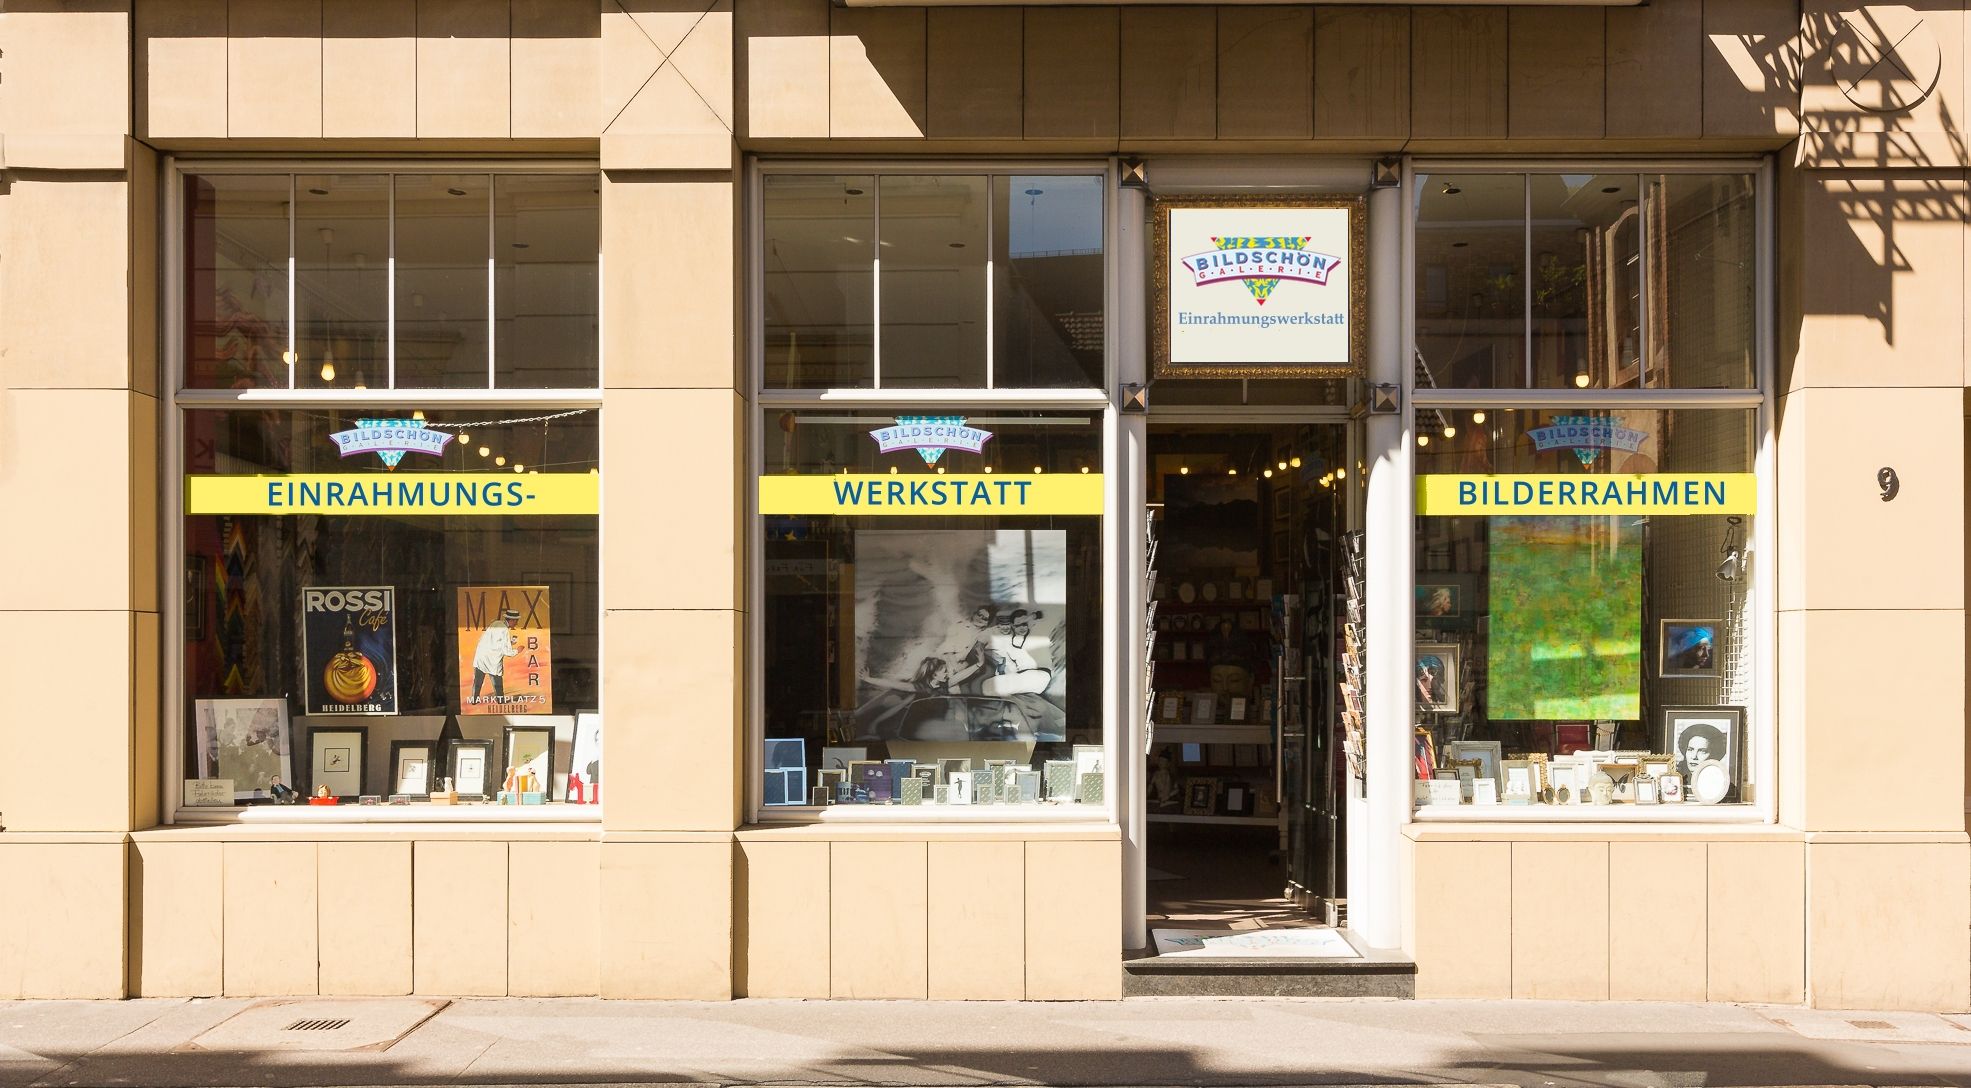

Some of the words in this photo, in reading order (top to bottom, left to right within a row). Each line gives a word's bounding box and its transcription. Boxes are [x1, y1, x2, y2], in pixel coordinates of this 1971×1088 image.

[1195, 251, 1327, 271] BILDSCHÖN
[1178, 311, 1345, 328] Einrahmungswerkstatt
[340, 429, 443, 445] BILDSCHÖN
[880, 427, 983, 443] BILDSCHÖN
[1536, 427, 1639, 443] BILDSCHÖN
[267, 481, 536, 507] EINRAHMUNGS-
[833, 480, 1032, 506] WERKSTATT
[1459, 480, 1727, 506] BILDERRAHMEN
[1877, 466, 1900, 502] 9
[306, 590, 391, 612] ROSSI
[464, 589, 544, 632] MAX
[358, 608, 389, 632] Café
[322, 703, 382, 712] HEIDELBERG
[466, 695, 537, 704] MARKTPLATZ
[539, 695, 546, 704] 5
[487, 704, 528, 714] HEIDELBERG
